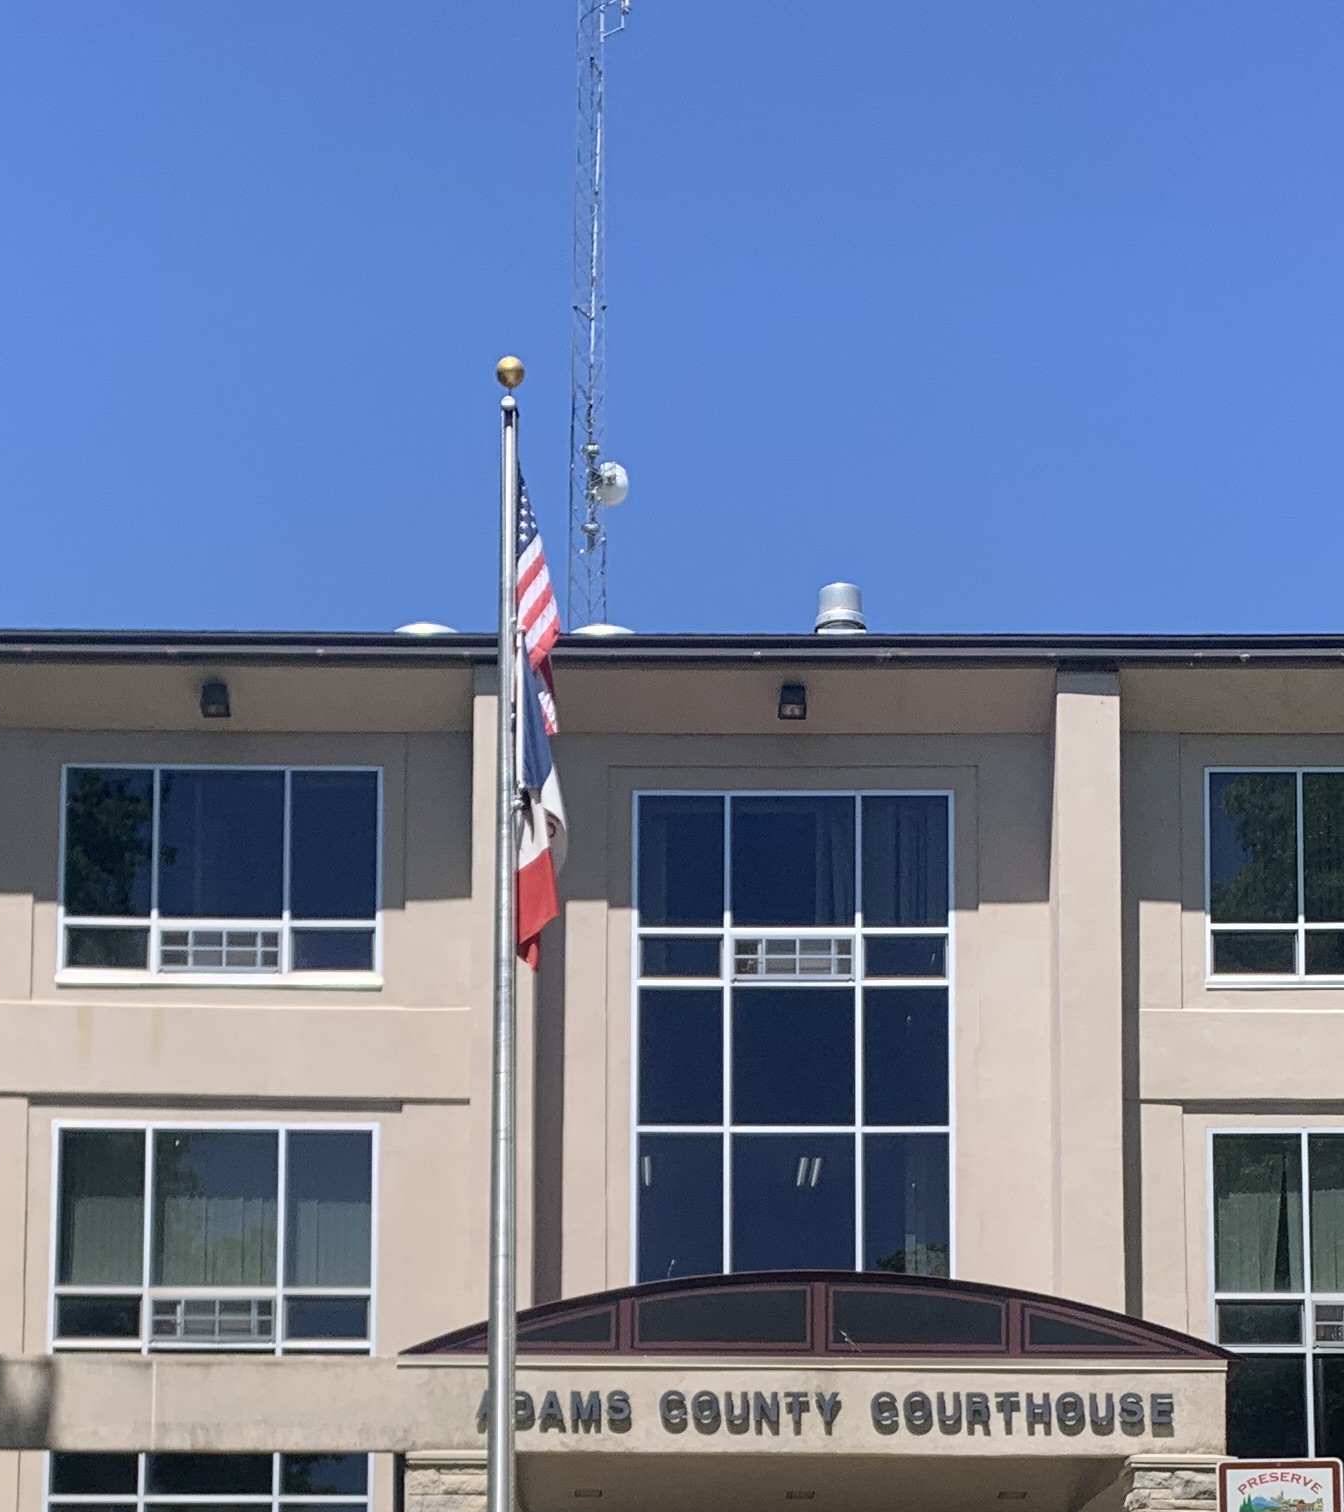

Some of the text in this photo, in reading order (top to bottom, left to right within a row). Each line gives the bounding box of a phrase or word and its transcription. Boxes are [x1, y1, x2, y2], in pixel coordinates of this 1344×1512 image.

[658, 1389, 841, 1422] COUNTY
[869, 1390, 1174, 1424] COURTHOUSE
[1236, 1472, 1323, 1495] PRESERVE
